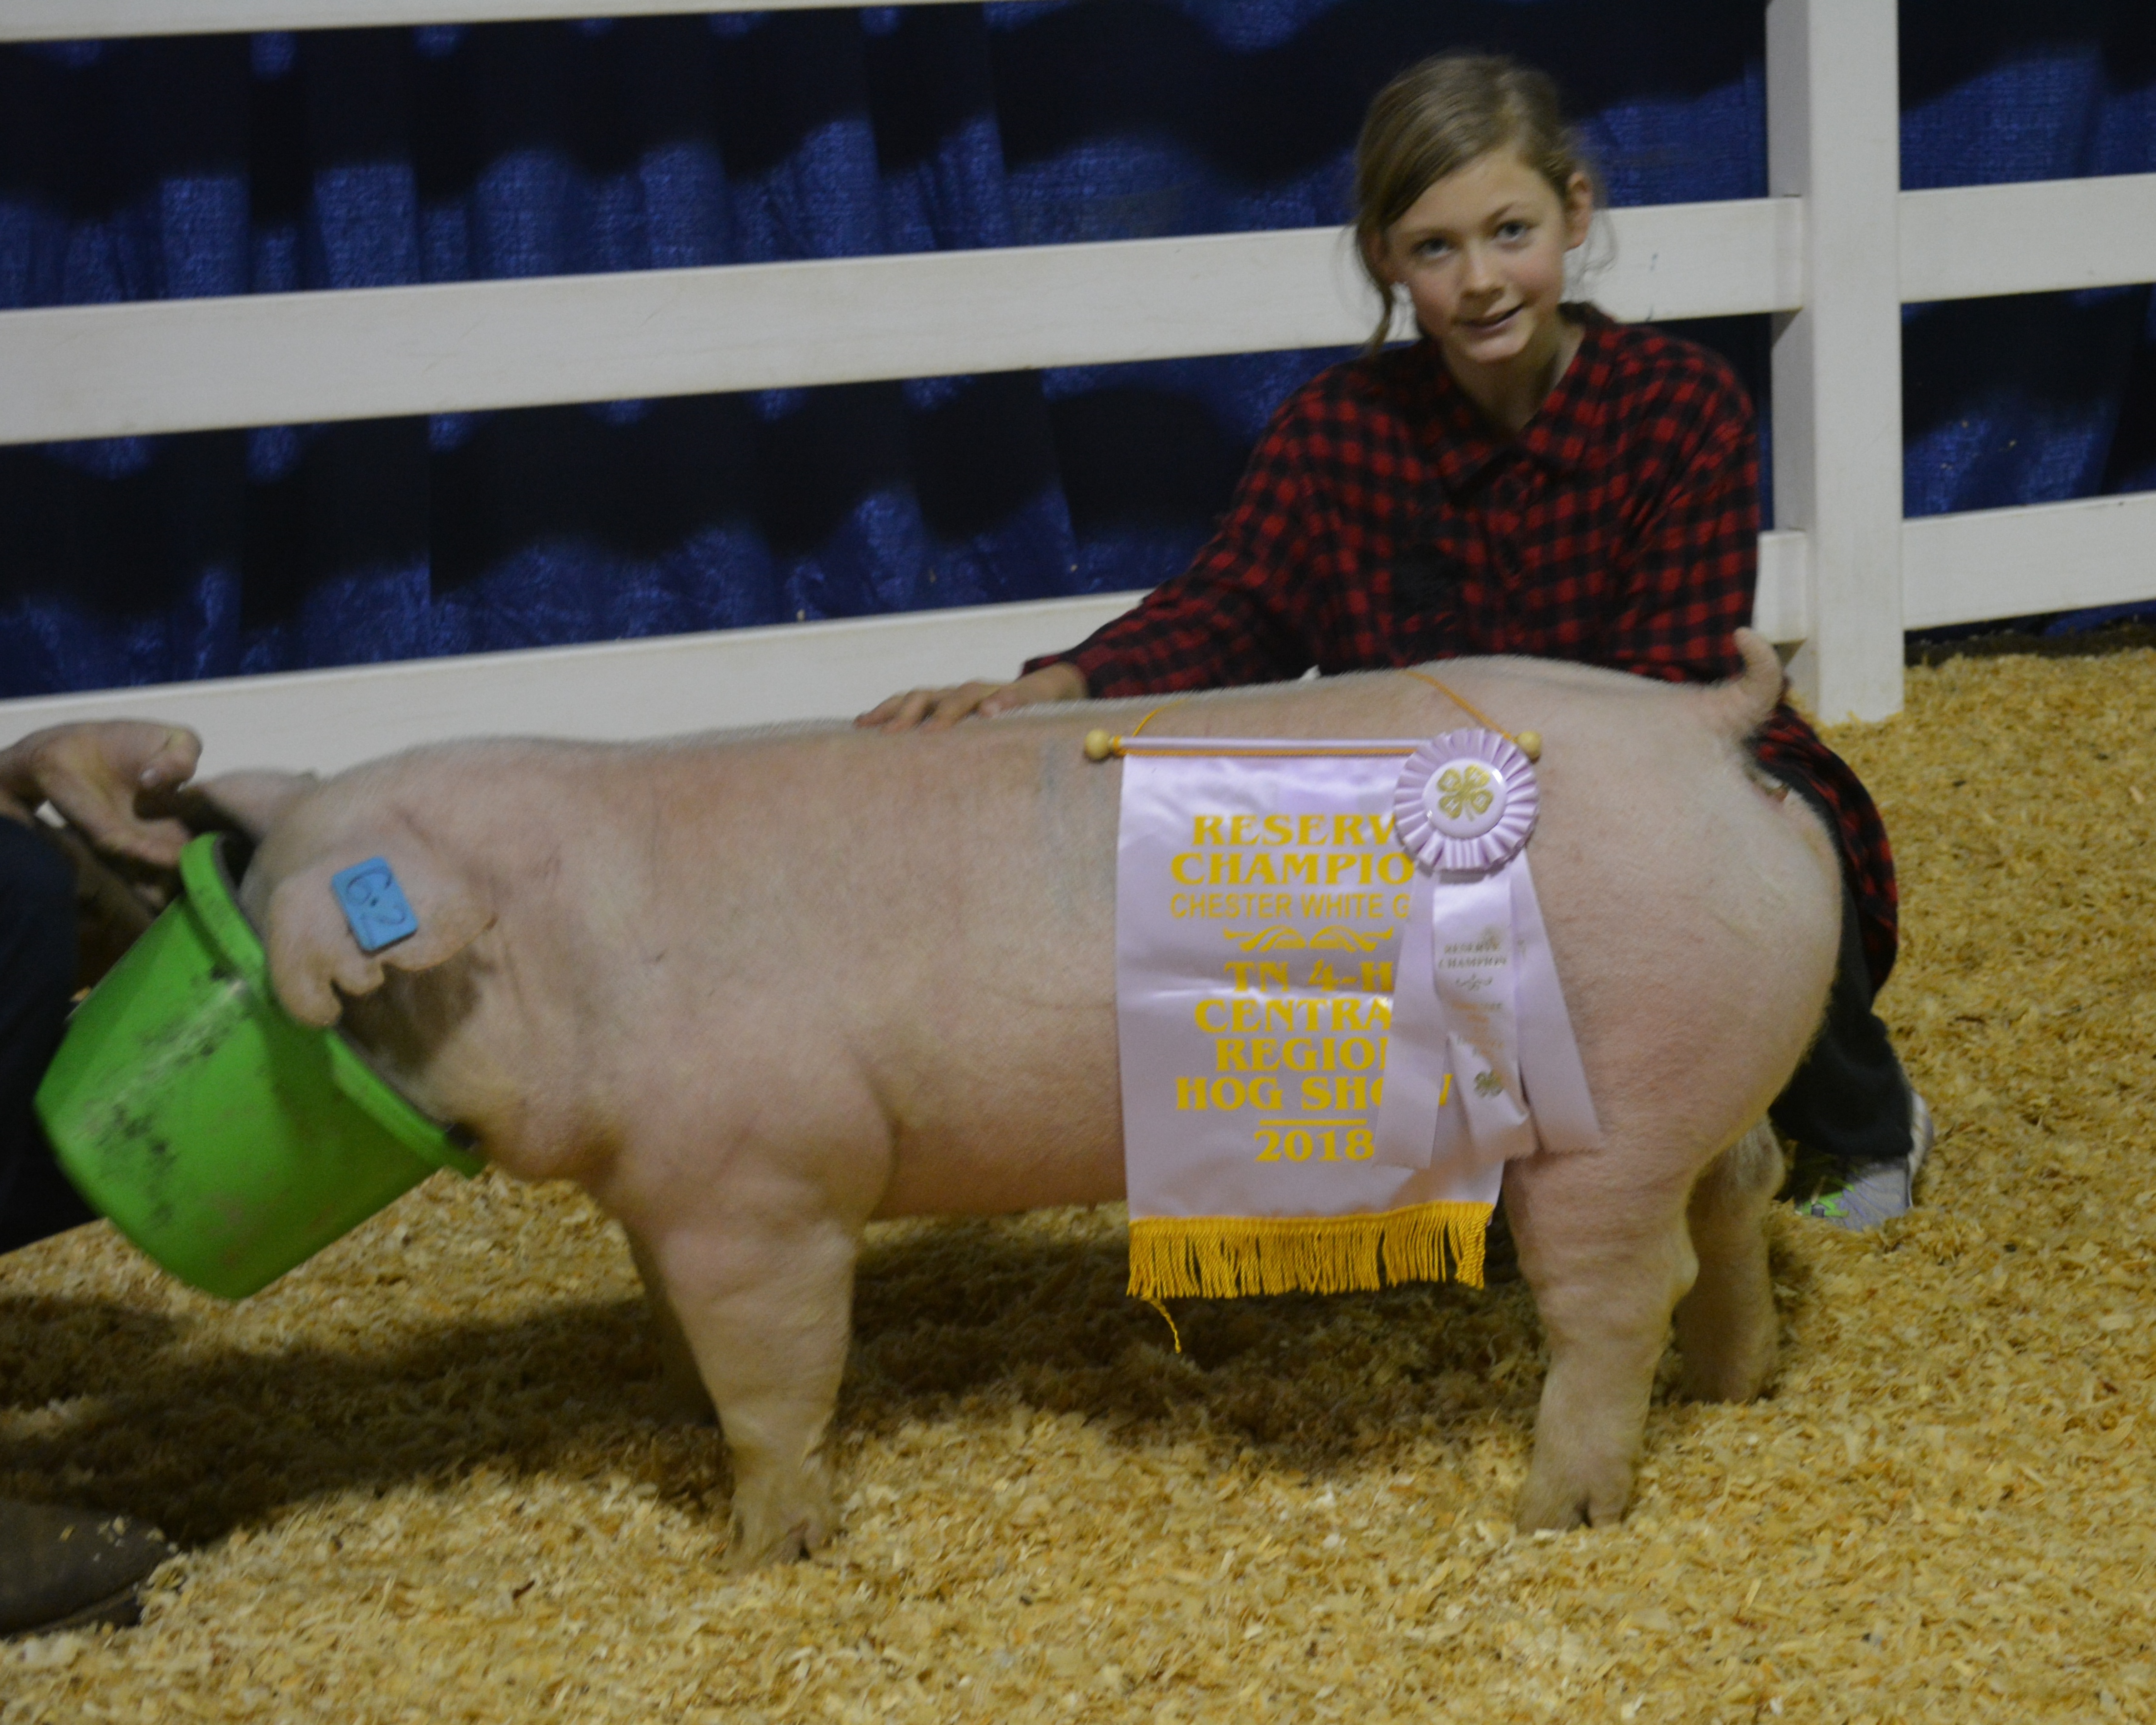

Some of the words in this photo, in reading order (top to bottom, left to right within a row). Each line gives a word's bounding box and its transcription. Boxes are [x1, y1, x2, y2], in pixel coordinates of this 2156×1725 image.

[1192, 814, 1397, 846] RESERV
[1171, 852, 1415, 885] CHAMPIO
[1170, 893, 1292, 919] CHESTER
[1300, 893, 1384, 919] WHITE
[1392, 893, 1410, 919] G
[1224, 961, 1289, 993] TN
[1307, 958, 1394, 993] 4-H
[1194, 998, 1392, 1033] CENTRA
[1175, 1076, 1283, 1111] HOG
[1301, 1073, 1454, 1111] SH
[1254, 1129, 1375, 1163] 2018
